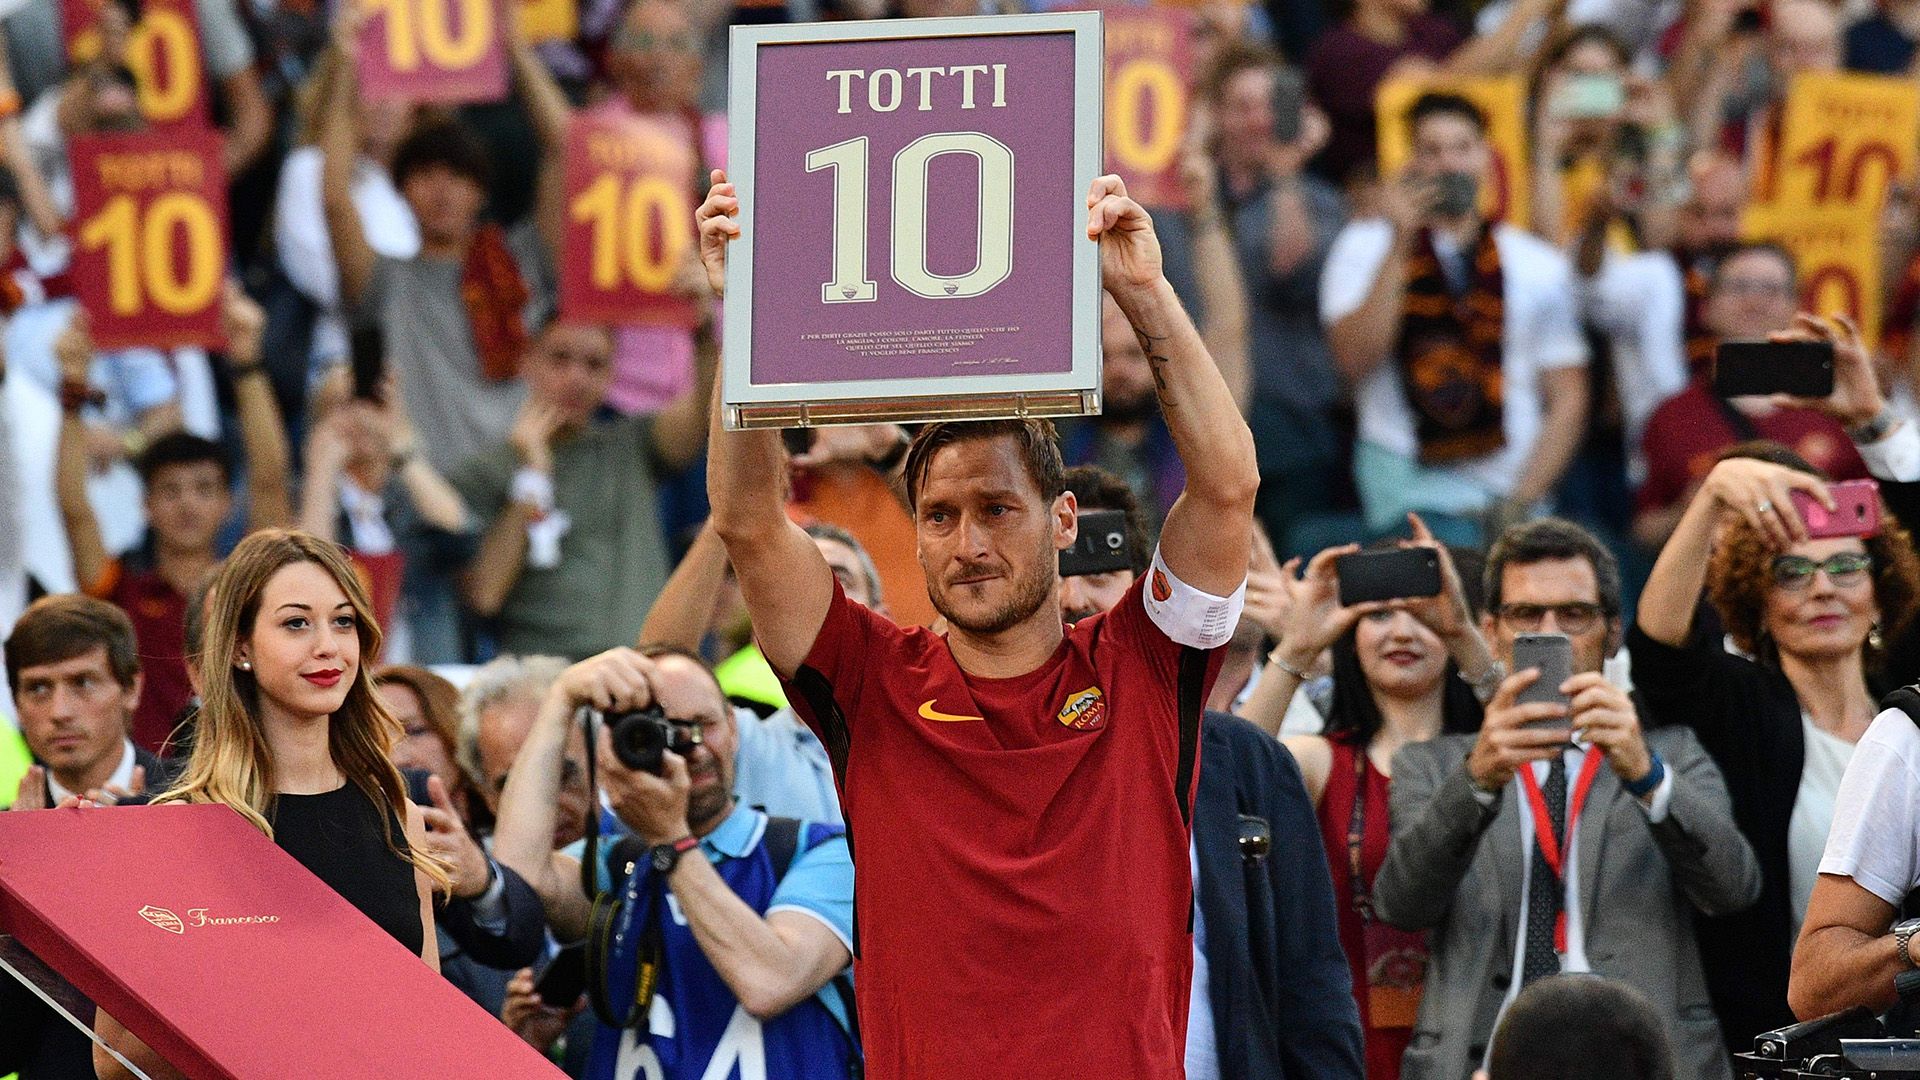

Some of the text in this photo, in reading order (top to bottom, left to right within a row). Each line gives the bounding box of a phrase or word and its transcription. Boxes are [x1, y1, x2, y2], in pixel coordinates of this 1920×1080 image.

[826, 63, 1007, 114] TOTTI
[81, 192, 222, 317] 10
[569, 174, 684, 292] 10
[806, 131, 1015, 304] 10
[1075, 702, 1104, 729] ROMA
[187, 908, 280, 928] Francesco
